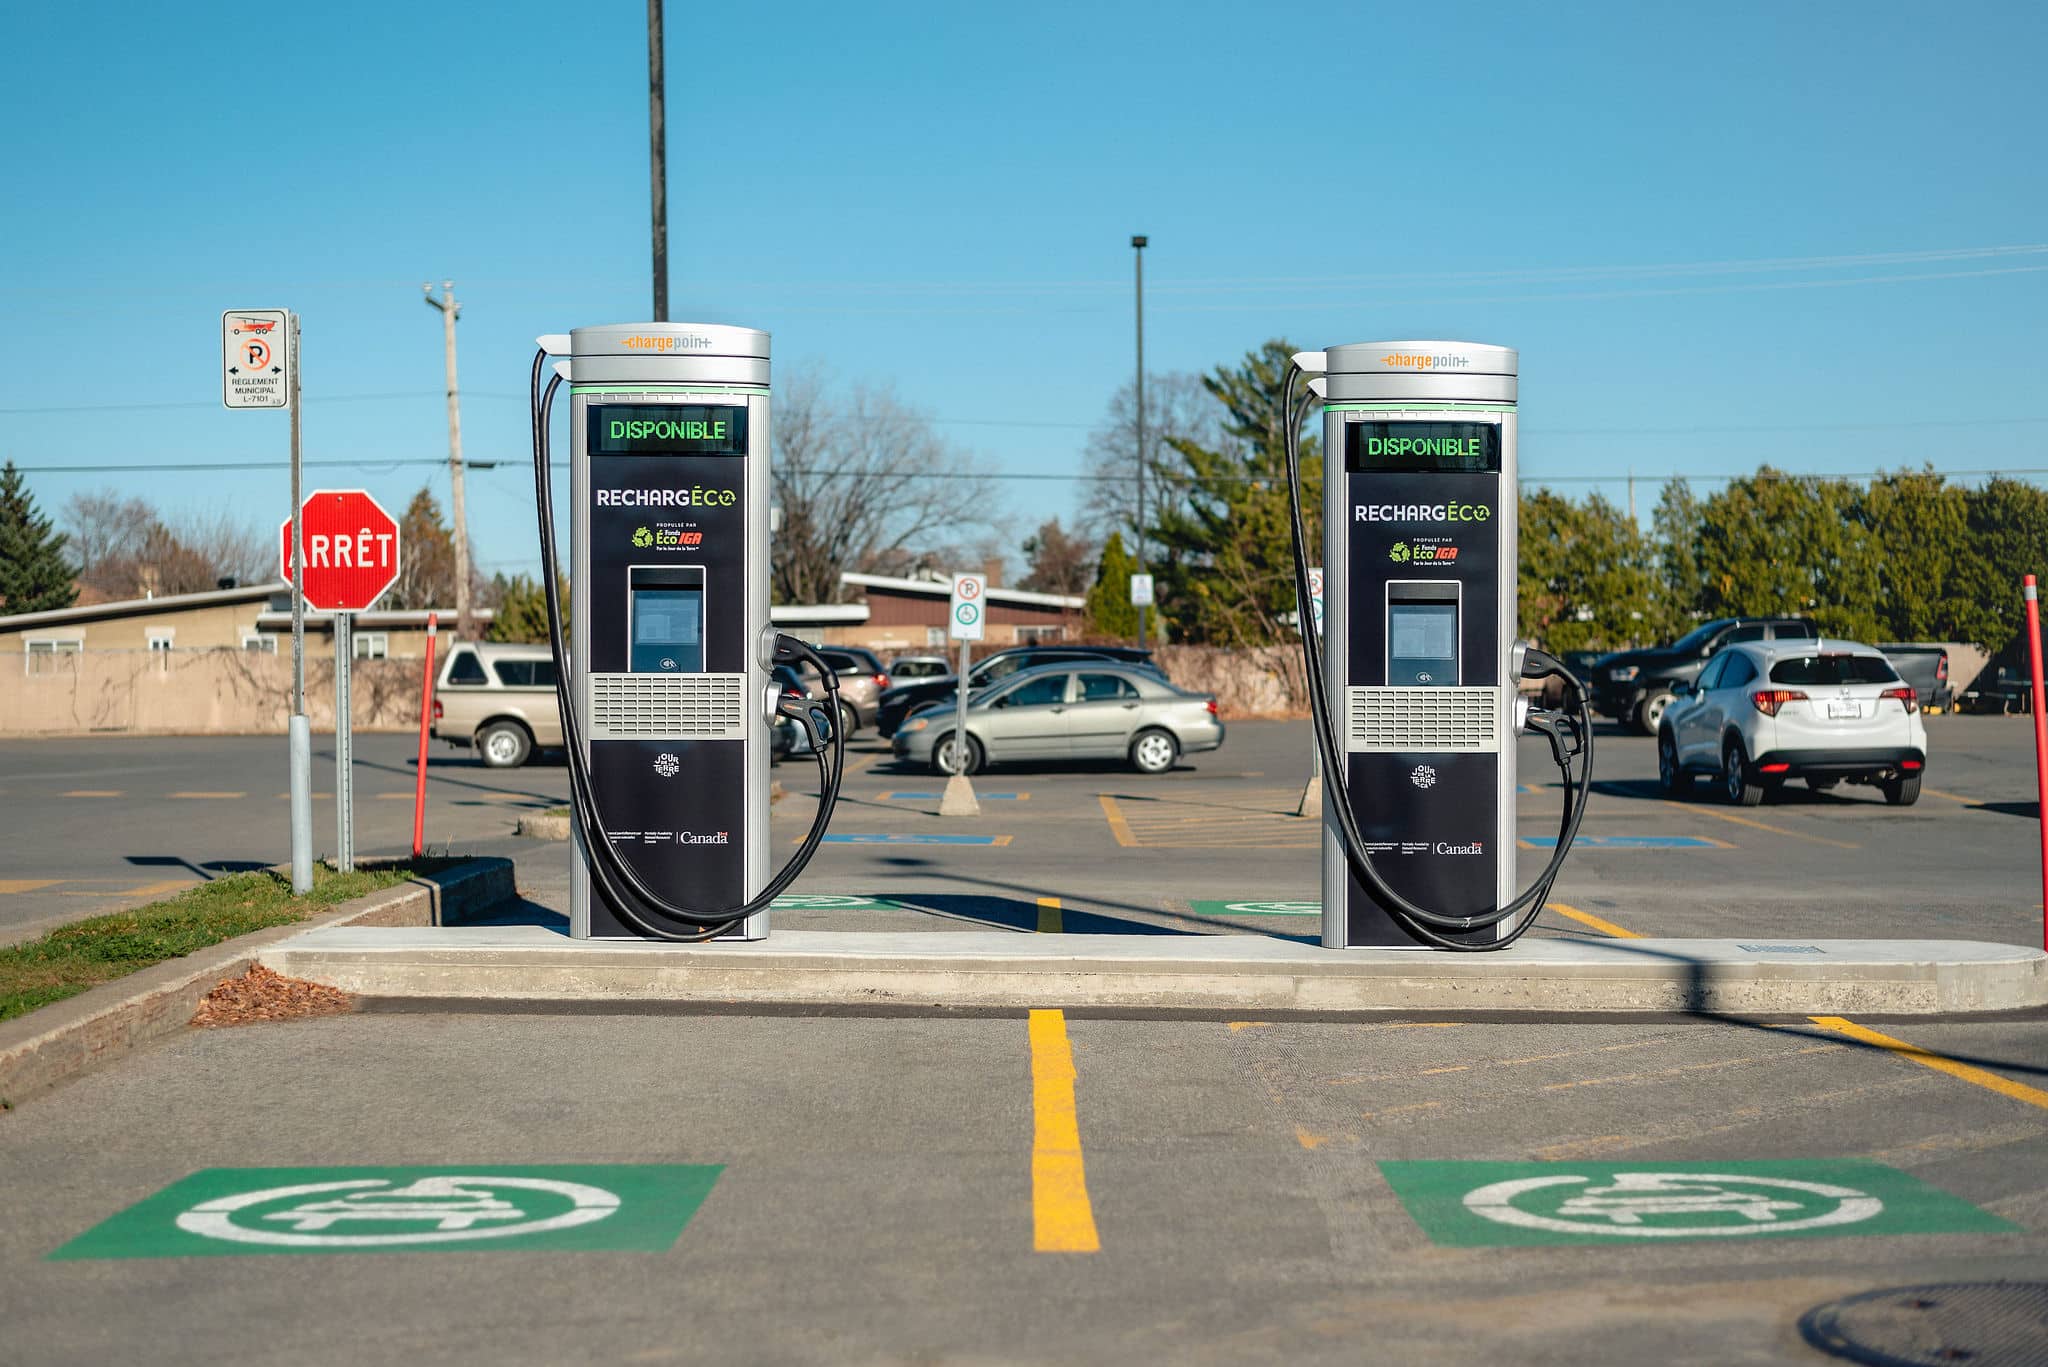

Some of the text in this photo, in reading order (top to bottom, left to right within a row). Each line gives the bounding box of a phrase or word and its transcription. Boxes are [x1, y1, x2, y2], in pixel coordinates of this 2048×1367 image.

[234, 386, 277, 394] MUNICIPAL
[610, 421, 726, 439] DISPONIBLE
[1368, 437, 1480, 456] DISPONIBLE
[678, 532, 703, 545] IGA
[1434, 547, 1458, 560] IGA
[654, 753, 680, 764] JOUR
[652, 764, 680, 775] TERRE
[1411, 765, 1436, 776] JOUR
[1410, 776, 1436, 786] TERRE
[680, 831, 728, 844] Canada
[1437, 842, 1483, 855] Canada
